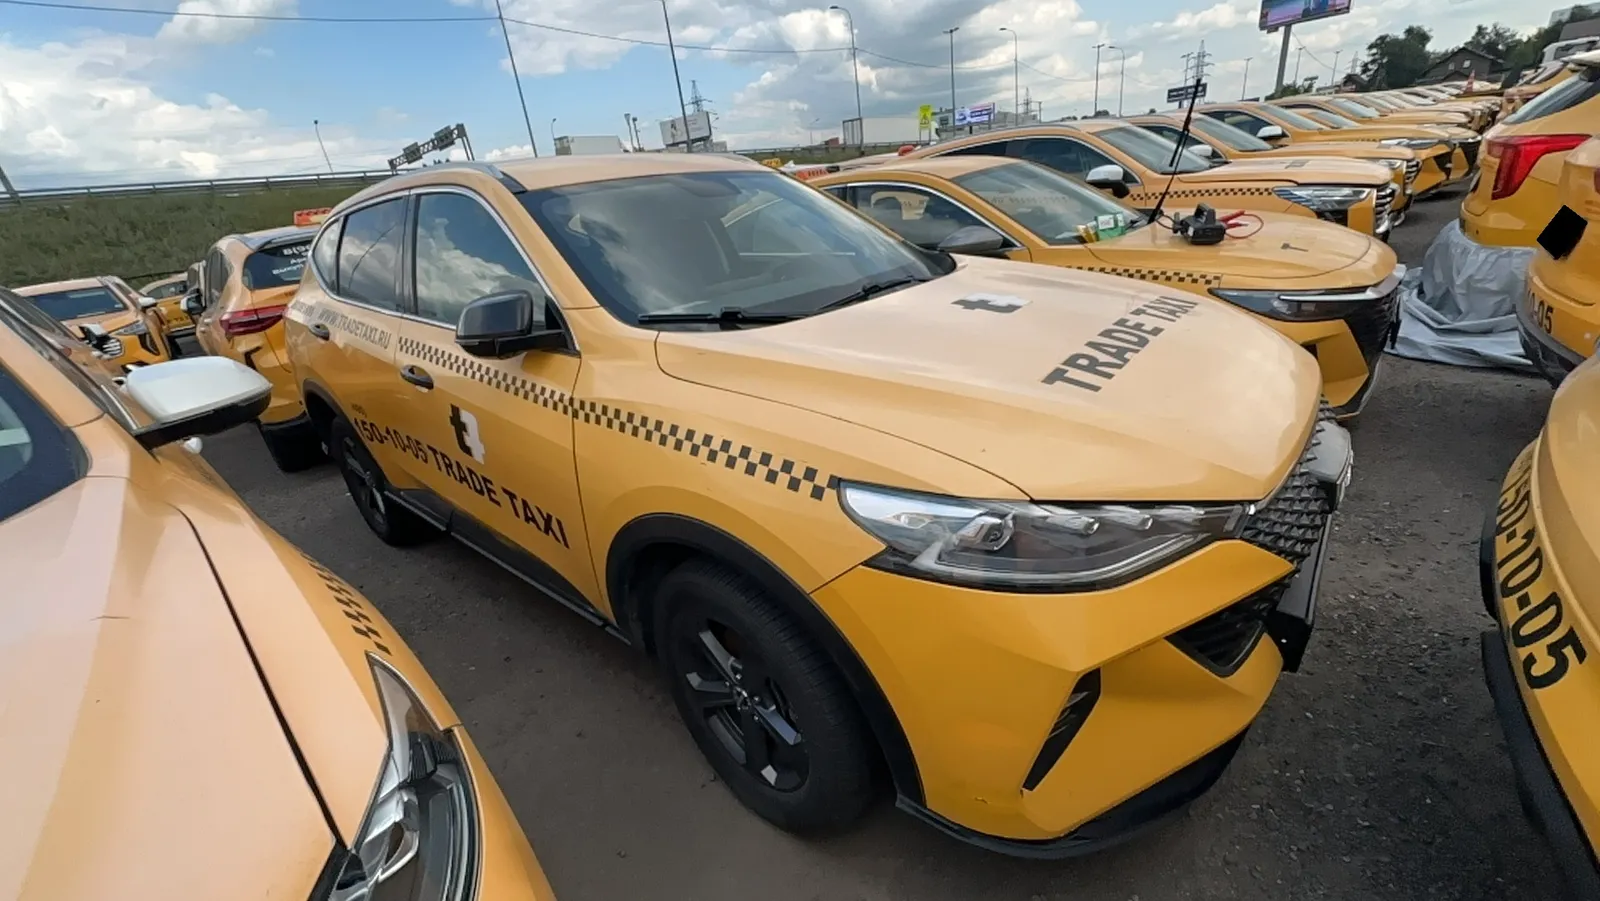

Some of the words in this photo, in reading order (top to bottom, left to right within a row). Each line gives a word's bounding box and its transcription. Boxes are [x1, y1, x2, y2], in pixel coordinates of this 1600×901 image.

[318, 307, 392, 350] WWW.TRADETAXI.RU
[1041, 317, 1166, 393] TRADE
[1130, 295, 1200, 323] TAXI
[353, 416, 430, 465] 150-10-05
[427, 444, 502, 508] TRADE
[501, 486, 571, 550] TAXI
